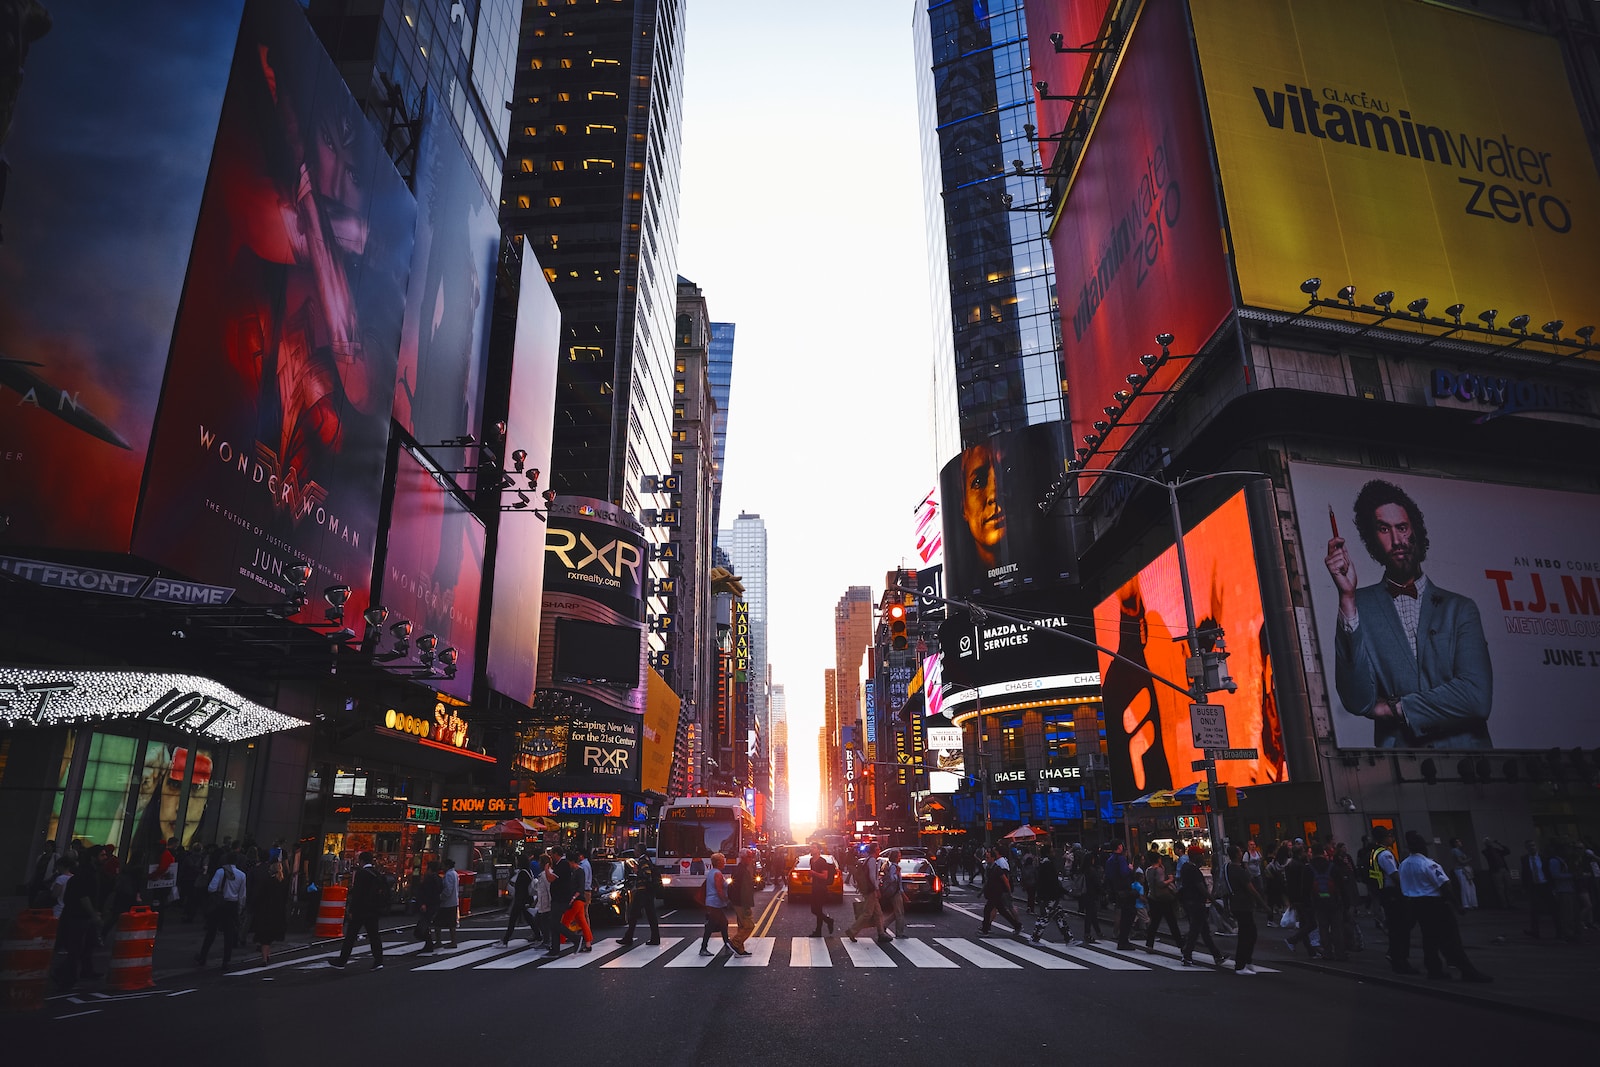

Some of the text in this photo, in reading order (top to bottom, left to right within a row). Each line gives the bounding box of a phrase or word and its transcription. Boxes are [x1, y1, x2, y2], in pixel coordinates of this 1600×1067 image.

[1252, 83, 1552, 188] vitaminwater
[1458, 176, 1572, 235] zero
[1137, 181, 1181, 289] zero
[1431, 368, 1591, 411] DOW JONES
[199, 425, 361, 549] WONDER WOMAN
[205, 499, 220, 513] THE
[223, 510, 251, 530] FUTURE
[253, 526, 264, 536] OF
[266, 534, 292, 553] JUSTICE
[252, 548, 286, 577] JUN
[545, 527, 640, 585] RXR
[1514, 557, 1529, 567] AN
[1535, 558, 1561, 569] HBO
[661, 477, 677, 667] CHAMPS
[987, 562, 1019, 578] EQUALITY.
[567, 571, 621, 588] rxrrealty.com
[153, 583, 226, 605] PRIME
[392, 566, 474, 630] WONDER WOMAN
[1485, 570, 1600, 615] T.J. M
[541, 601, 580, 610] SHARP
[736, 602, 749, 669] MADAME
[983, 624, 1017, 639] MAZDA
[984, 634, 1029, 650] SERVICES
[1543, 649, 1586, 666] JUNE
[1005, 681, 1033, 691] CHASE
[960, 691, 977, 700] CHASE
[147, 688, 239, 734] LOFT
[1197, 708, 1219, 716] BUSES
[607, 722, 624, 733] New
[623, 724, 636, 734] York
[867, 716, 876, 741] STUDIOS
[572, 731, 637, 748] for the 21st Century
[912, 714, 924, 775] NW VICTORY
[583, 746, 630, 768] RXR
[1224, 751, 1257, 759] Broadway
[593, 767, 622, 775] REALTY
[845, 749, 855, 802] REGAL
[995, 771, 1026, 783] CHASE
[1040, 768, 1081, 779] CHASE
[442, 799, 450, 812] E
[452, 799, 485, 812] KNOW
[548, 796, 614, 814] CHAMPS
[1179, 817, 1201, 828] SODA
